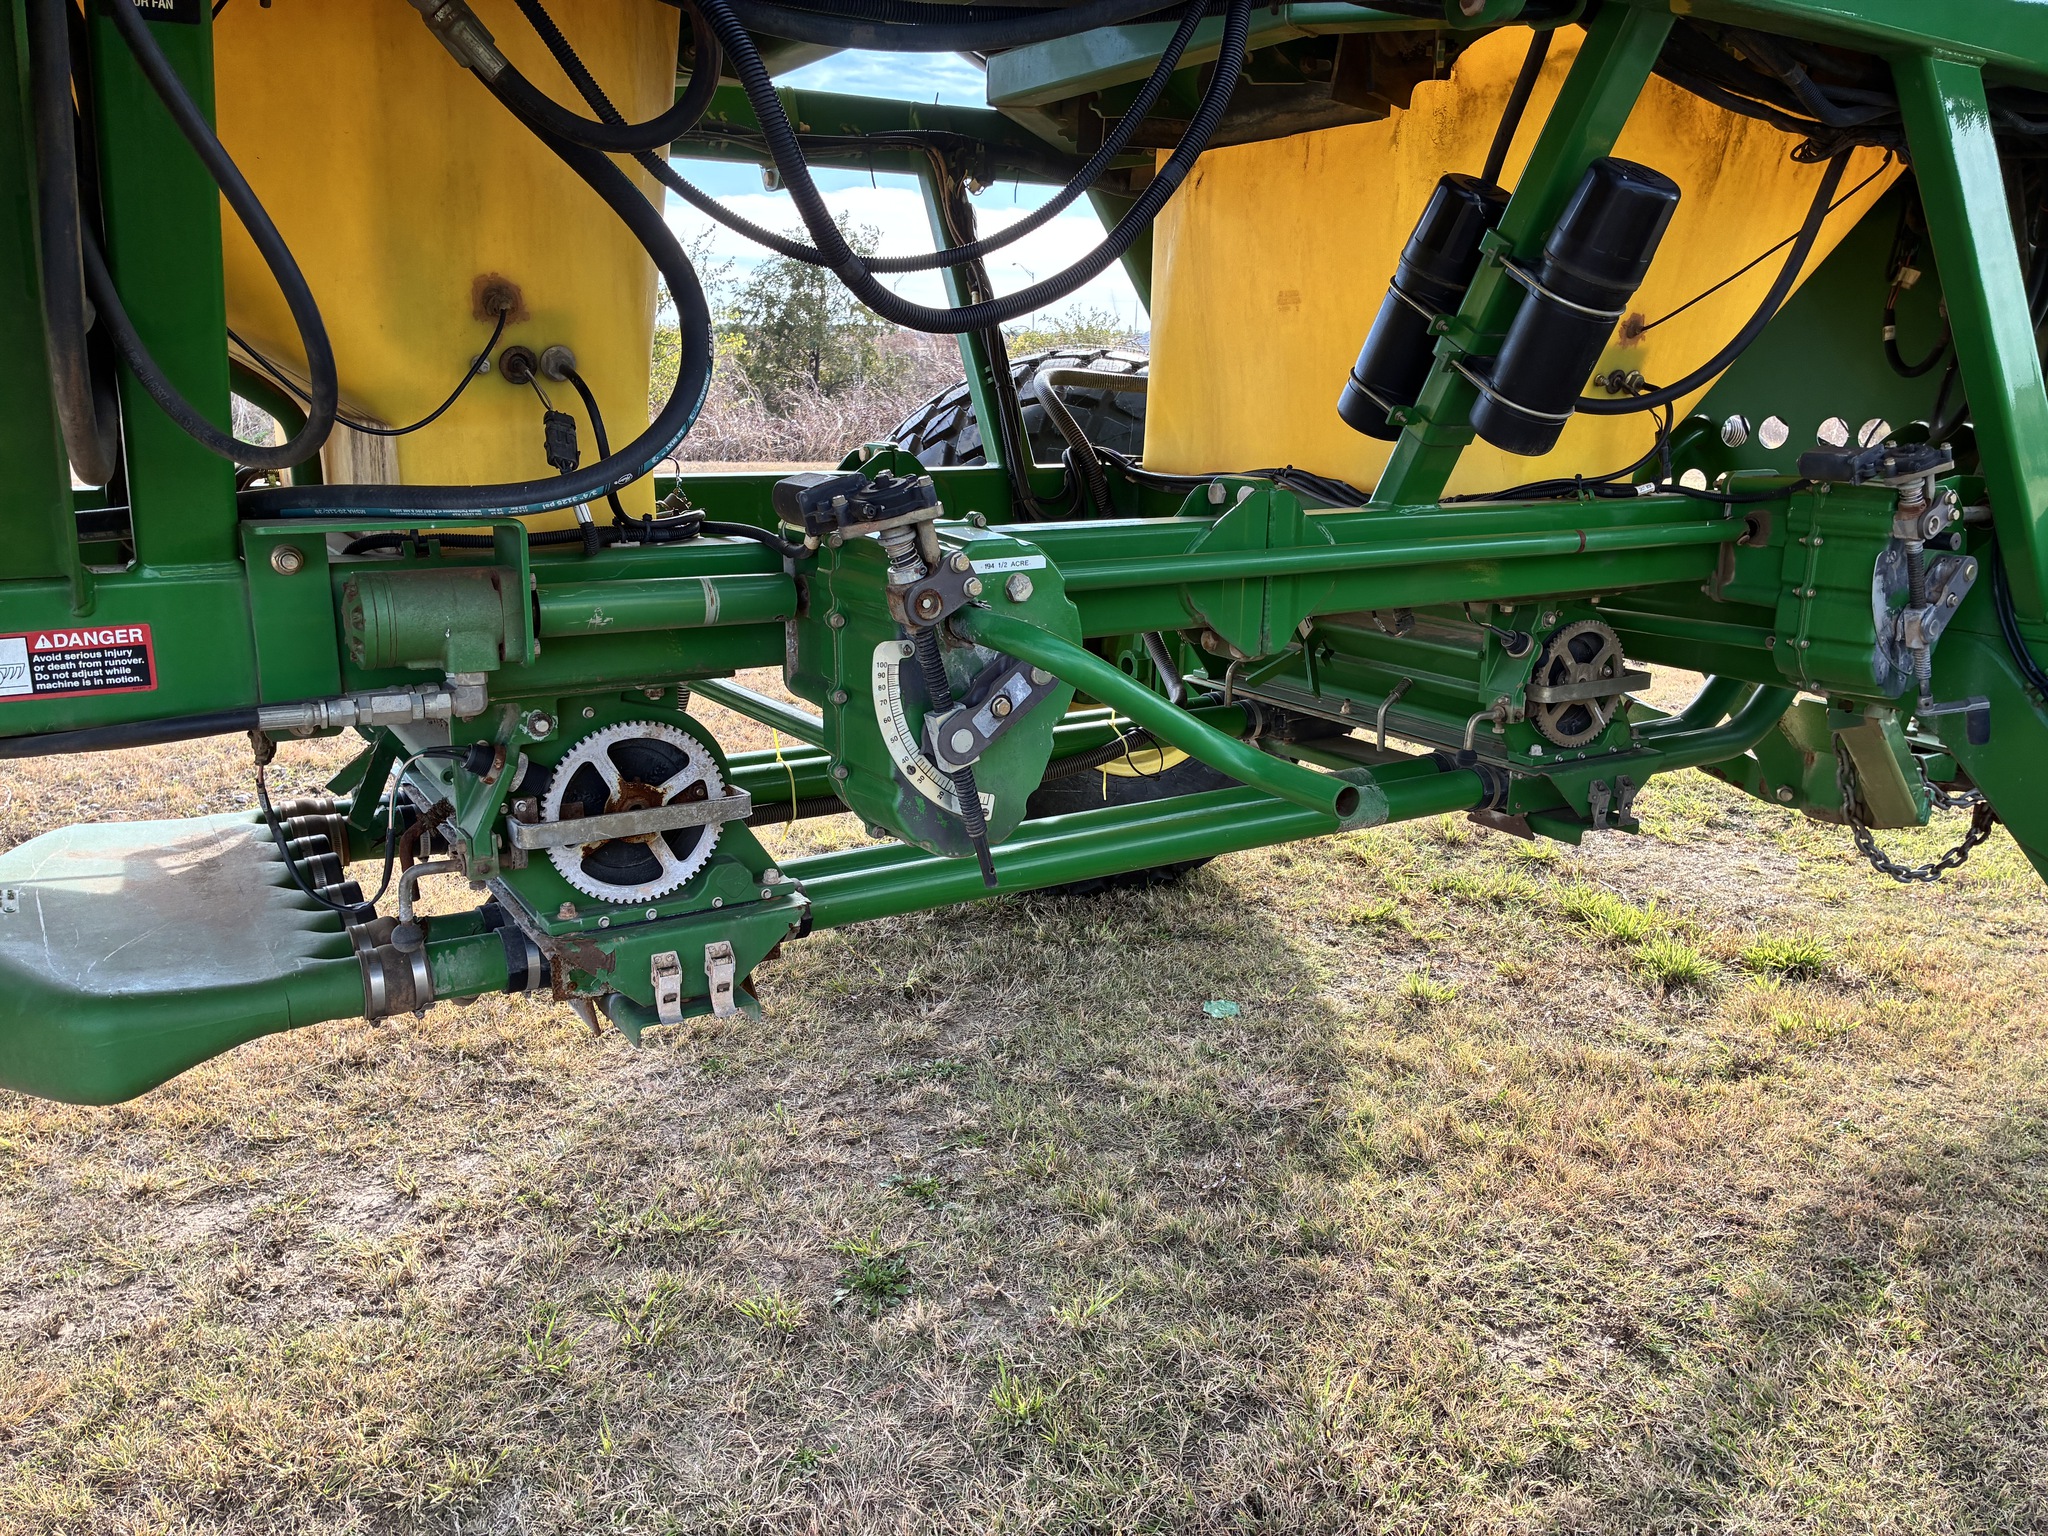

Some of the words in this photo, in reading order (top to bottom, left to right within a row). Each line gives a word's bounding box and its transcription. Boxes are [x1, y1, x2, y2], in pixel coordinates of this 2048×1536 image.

[542, 501, 555, 509] psi
[998, 561, 1008, 569] 1/2
[1010, 560, 1029, 568] ACRE
[53, 628, 143, 648] DANGER
[32, 653, 62, 663] Avoid
[64, 650, 103, 660] serious
[104, 648, 133, 660] injury
[33, 664, 45, 672] or
[47, 661, 76, 671] death
[78, 659, 102, 669] from
[104, 657, 145, 667] runover.
[35, 672, 49, 681] Do
[52, 670, 70, 680] not
[72, 668, 103, 680] adjust
[105, 666, 131, 676] while
[36, 679, 80, 690] machine
[82, 678, 91, 687] is
[93, 677, 103, 685] in
[105, 675, 143, 685] motion.
[883, 716, 892, 724] 60
[890, 735, 899, 744] 50
[901, 755, 910, 764] 40
[917, 775, 925, 784] 30
[936, 790, 945, 800] 20
